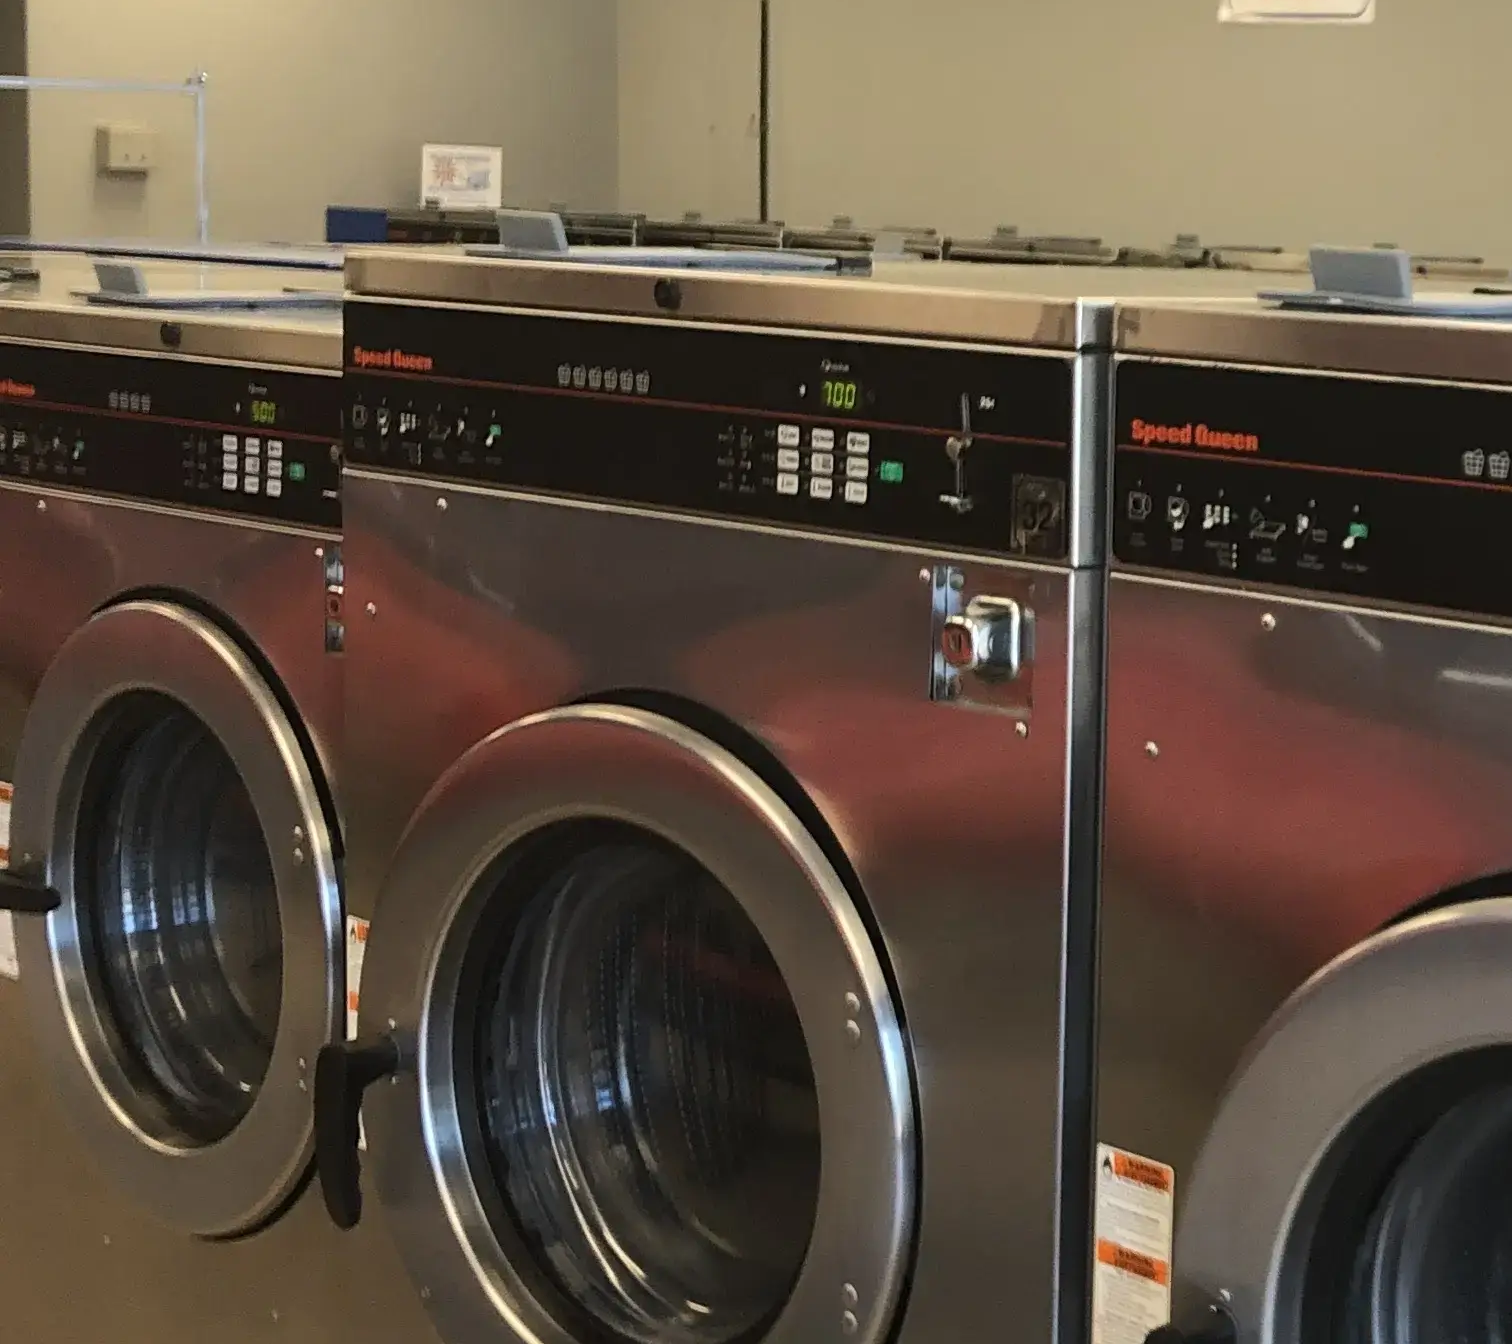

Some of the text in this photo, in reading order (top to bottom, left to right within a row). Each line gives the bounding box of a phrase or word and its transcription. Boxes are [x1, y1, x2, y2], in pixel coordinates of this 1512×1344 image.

[354, 346, 433, 371] Speed Queen
[1130, 417, 1259, 452] Speed Queen
